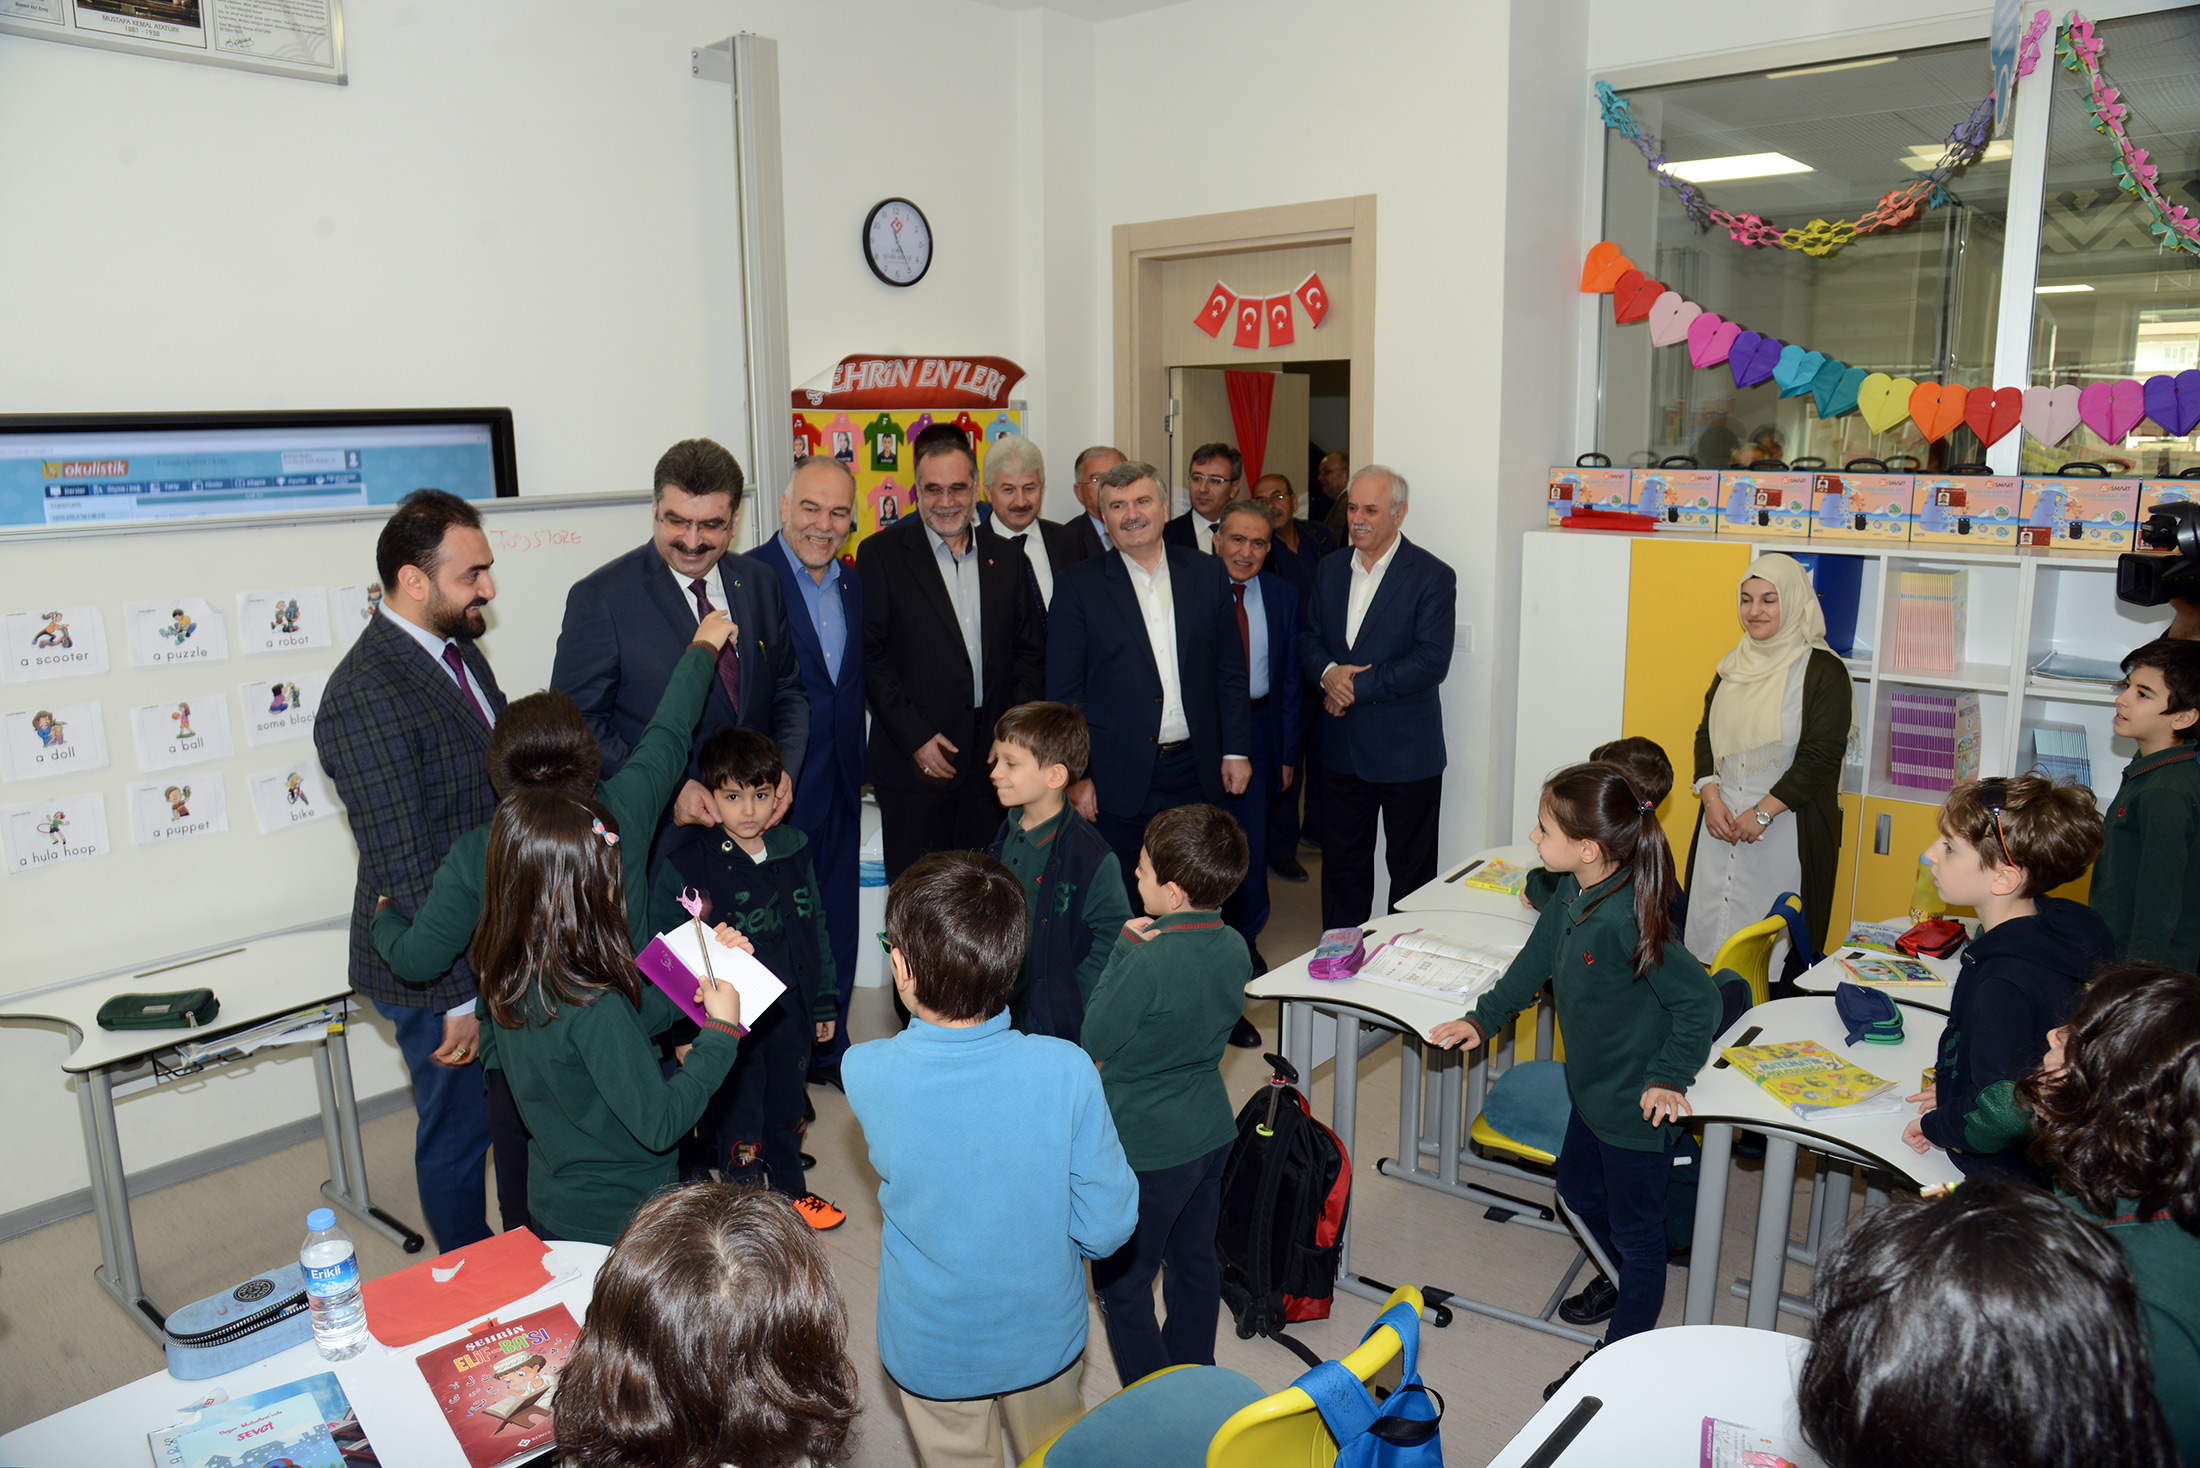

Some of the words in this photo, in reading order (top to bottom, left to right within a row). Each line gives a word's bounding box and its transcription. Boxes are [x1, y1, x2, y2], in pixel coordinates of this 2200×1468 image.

[102, 15, 131, 25] MUSTAFA
[132, 20, 153, 29] KEMAL
[154, 24, 180, 33] ATATÜRK
[145, 29, 160, 37] 1938
[806, 359, 917, 405] EHRİN
[64, 461, 126, 477] okulistik
[278, 635, 310, 646] robot
[20, 657, 29, 666] a
[36, 651, 90, 665] scooter
[153, 653, 160, 661] a
[167, 647, 208, 663] puzzle
[257, 720, 286, 731] some
[169, 745, 176, 753] a
[182, 737, 205, 751] ball
[35, 753, 43, 763] a
[51, 746, 76, 760] doll
[291, 809, 315, 822] bike
[153, 829, 160, 837] a
[166, 820, 210, 837] puppet
[19, 857, 27, 866] a
[33, 850, 58, 863] hula
[64, 843, 96, 860] hoop
[311, 1265, 341, 1280] Erikli
